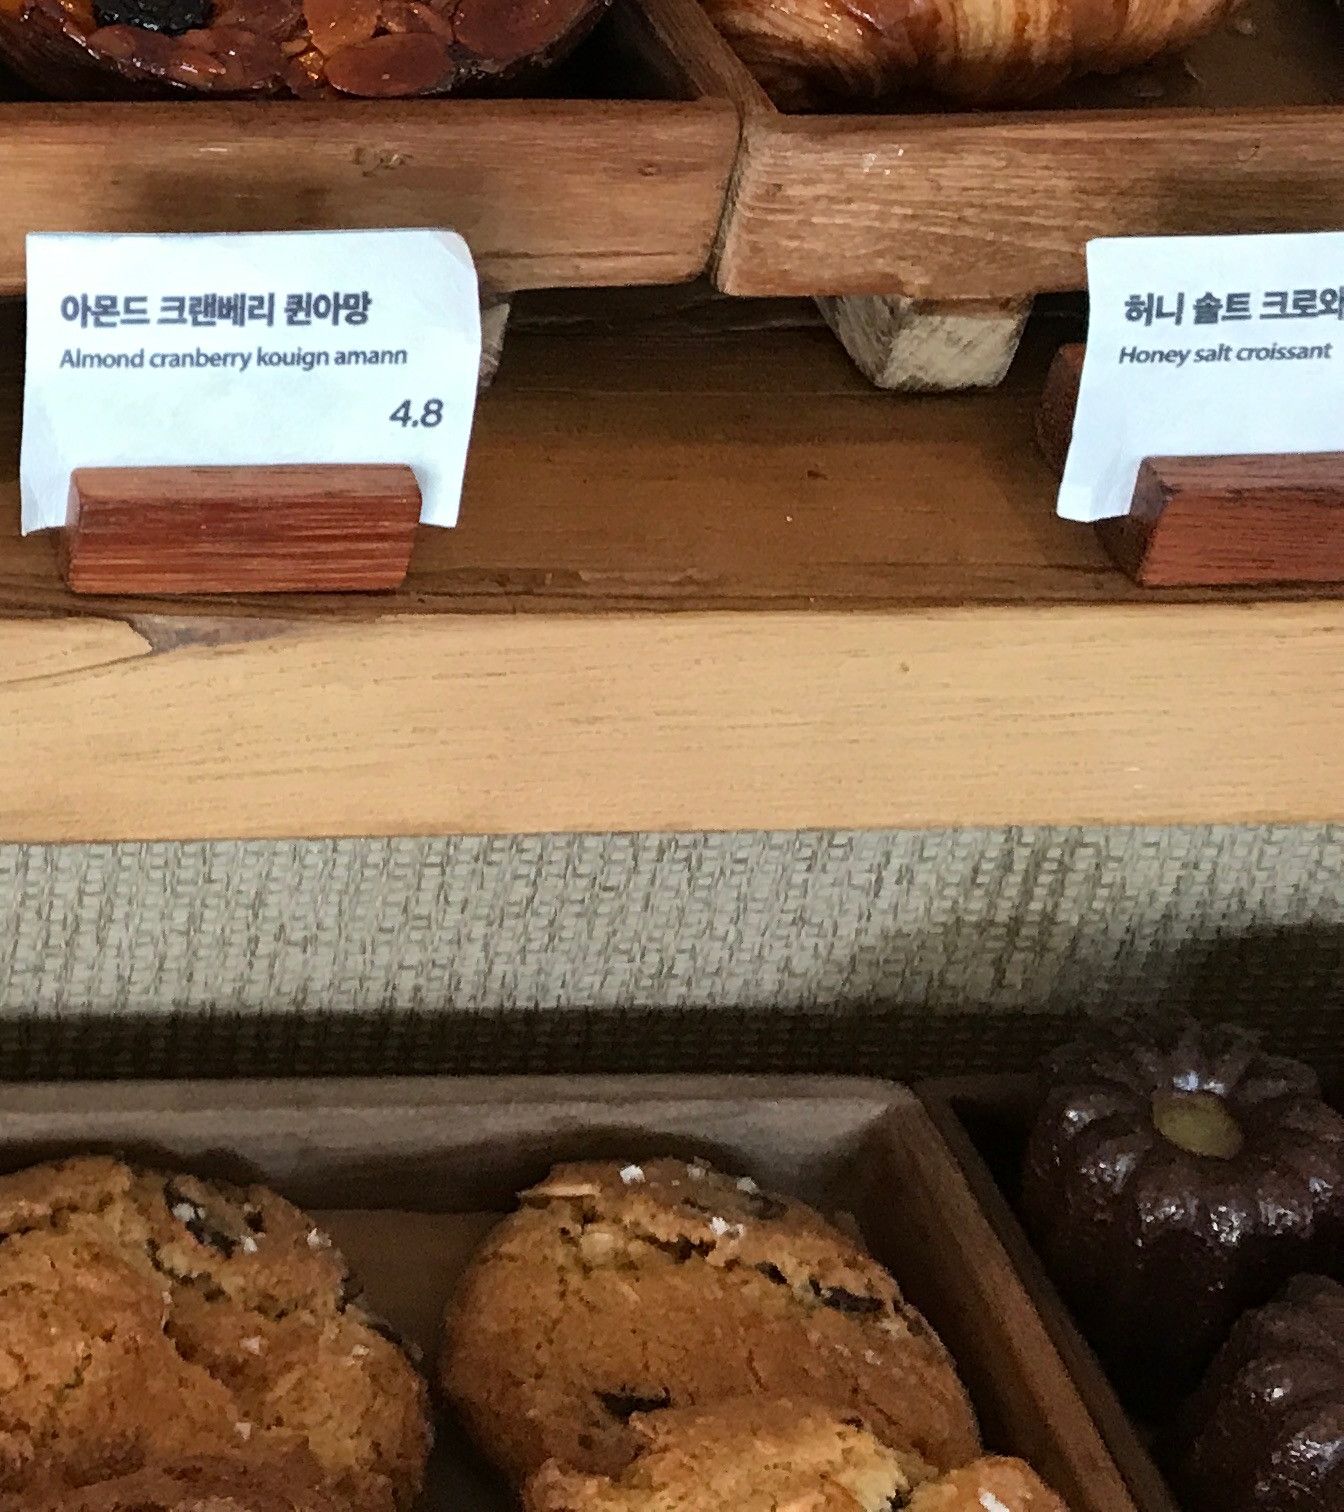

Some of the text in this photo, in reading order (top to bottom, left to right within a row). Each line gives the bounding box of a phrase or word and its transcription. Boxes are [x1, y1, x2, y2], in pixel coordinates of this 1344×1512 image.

[60, 290, 375, 329] 아몬드 크랜베리 퀸아망
[1124, 291, 1187, 328] 허니
[1192, 291, 1254, 326] 솔트
[59, 346, 409, 374] Almond cranberry kouign amann
[1118, 342, 1334, 369] Honey salt croissant
[389, 398, 445, 430] 4.8
